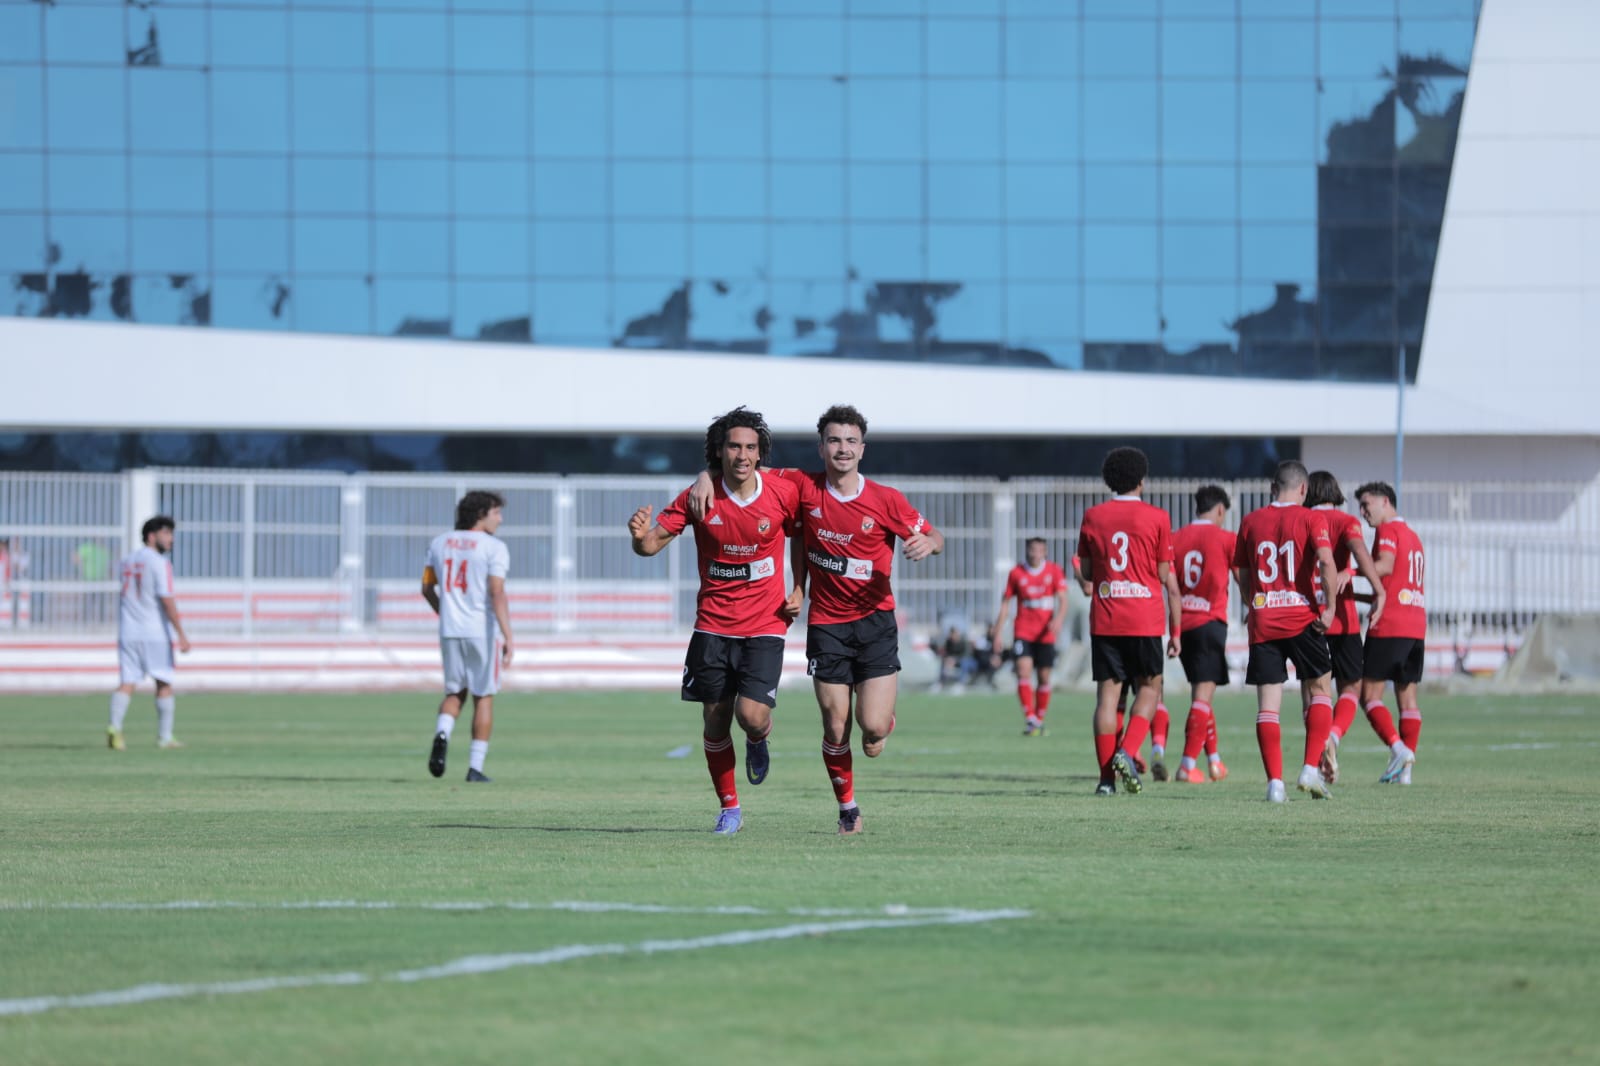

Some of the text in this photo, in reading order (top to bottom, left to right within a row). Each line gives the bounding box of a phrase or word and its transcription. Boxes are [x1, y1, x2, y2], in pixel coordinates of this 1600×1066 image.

[808, 552, 844, 572] etisalat
[1110, 531, 1129, 572] 3
[1183, 550, 1203, 589] 6
[1257, 540, 1296, 584] 31
[1408, 549, 1424, 588] 10
[444, 559, 468, 594] 14
[709, 565, 747, 578] etisalat
